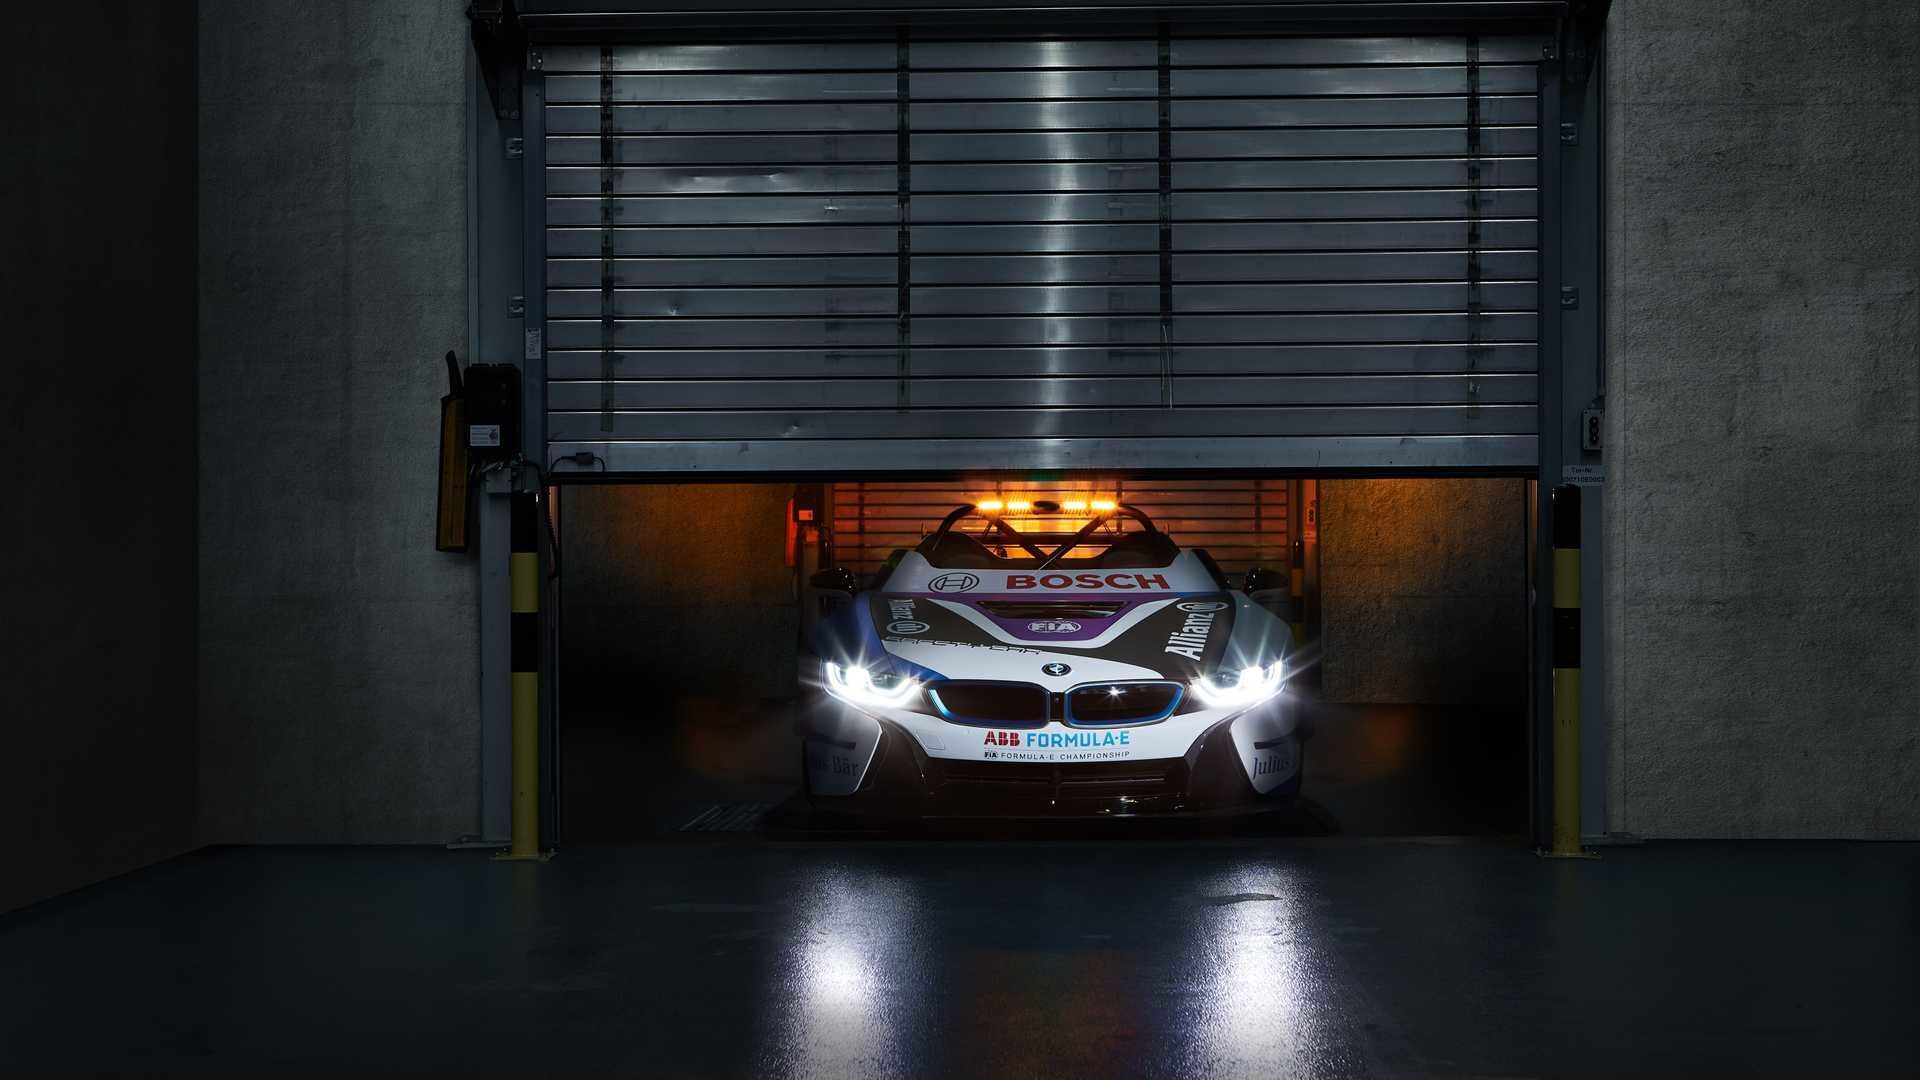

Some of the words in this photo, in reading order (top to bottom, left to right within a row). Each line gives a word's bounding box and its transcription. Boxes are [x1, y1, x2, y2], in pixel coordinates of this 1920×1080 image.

[1006, 574, 1171, 590] BOSCH
[1032, 621, 1076, 633] FIA
[1165, 612, 1215, 662] Allianz
[984, 730, 1020, 747] ABB
[984, 751, 998, 759] FIA
[1060, 751, 1130, 761] CHAMPIONSHIP
